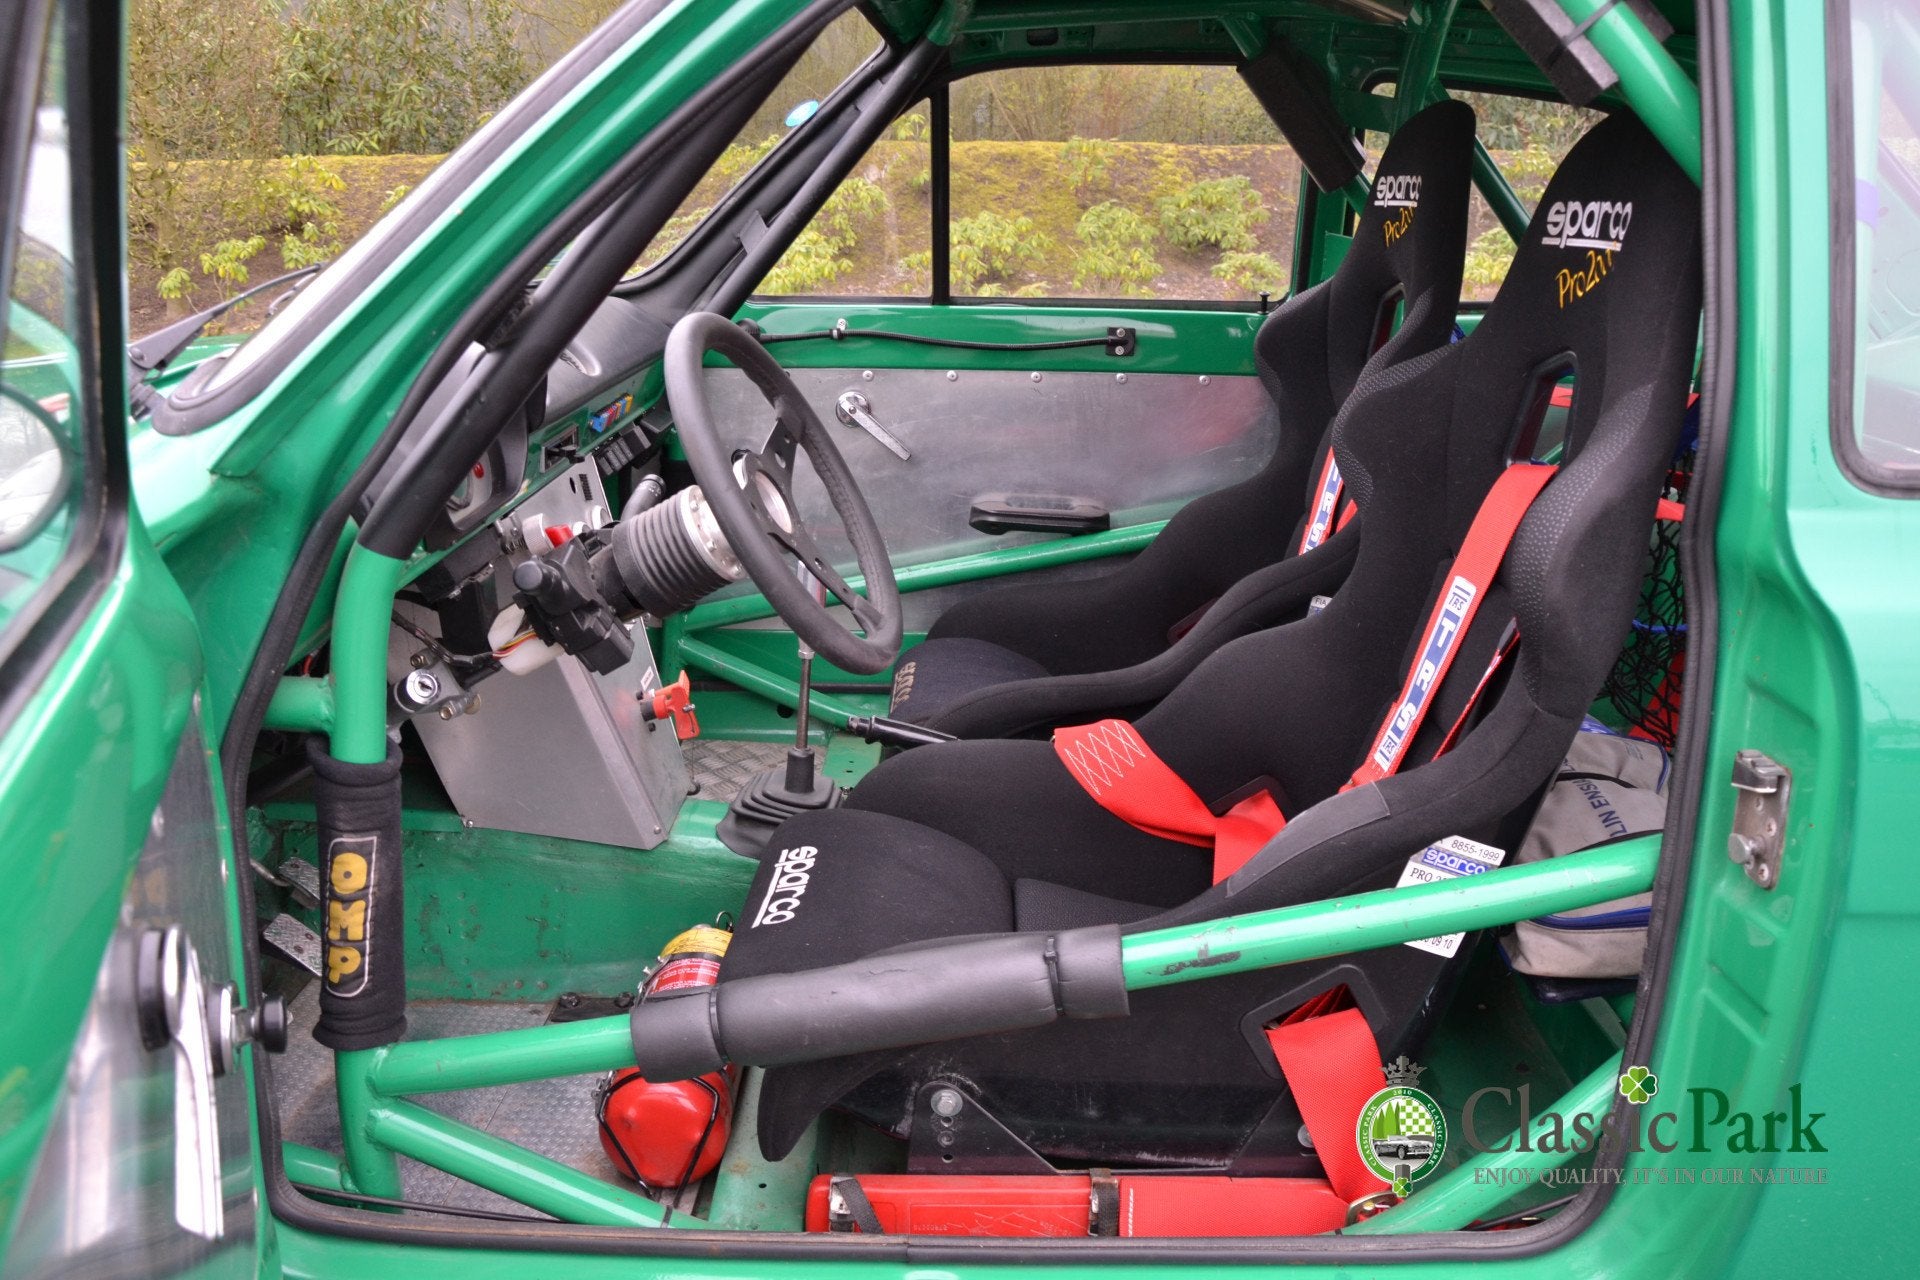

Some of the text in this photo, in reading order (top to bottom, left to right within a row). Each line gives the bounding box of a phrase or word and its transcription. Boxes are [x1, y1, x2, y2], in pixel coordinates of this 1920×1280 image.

[1541, 201, 1633, 252] sparco
[1449, 592, 1468, 611] TRS
[1398, 616, 1457, 732] TRS
[1424, 849, 1486, 876] sparco
[1451, 839, 1500, 862] 8855-1999
[752, 846, 818, 928] sparco
[1410, 867, 1433, 883] PRO
[328, 852, 367, 984] OMP
